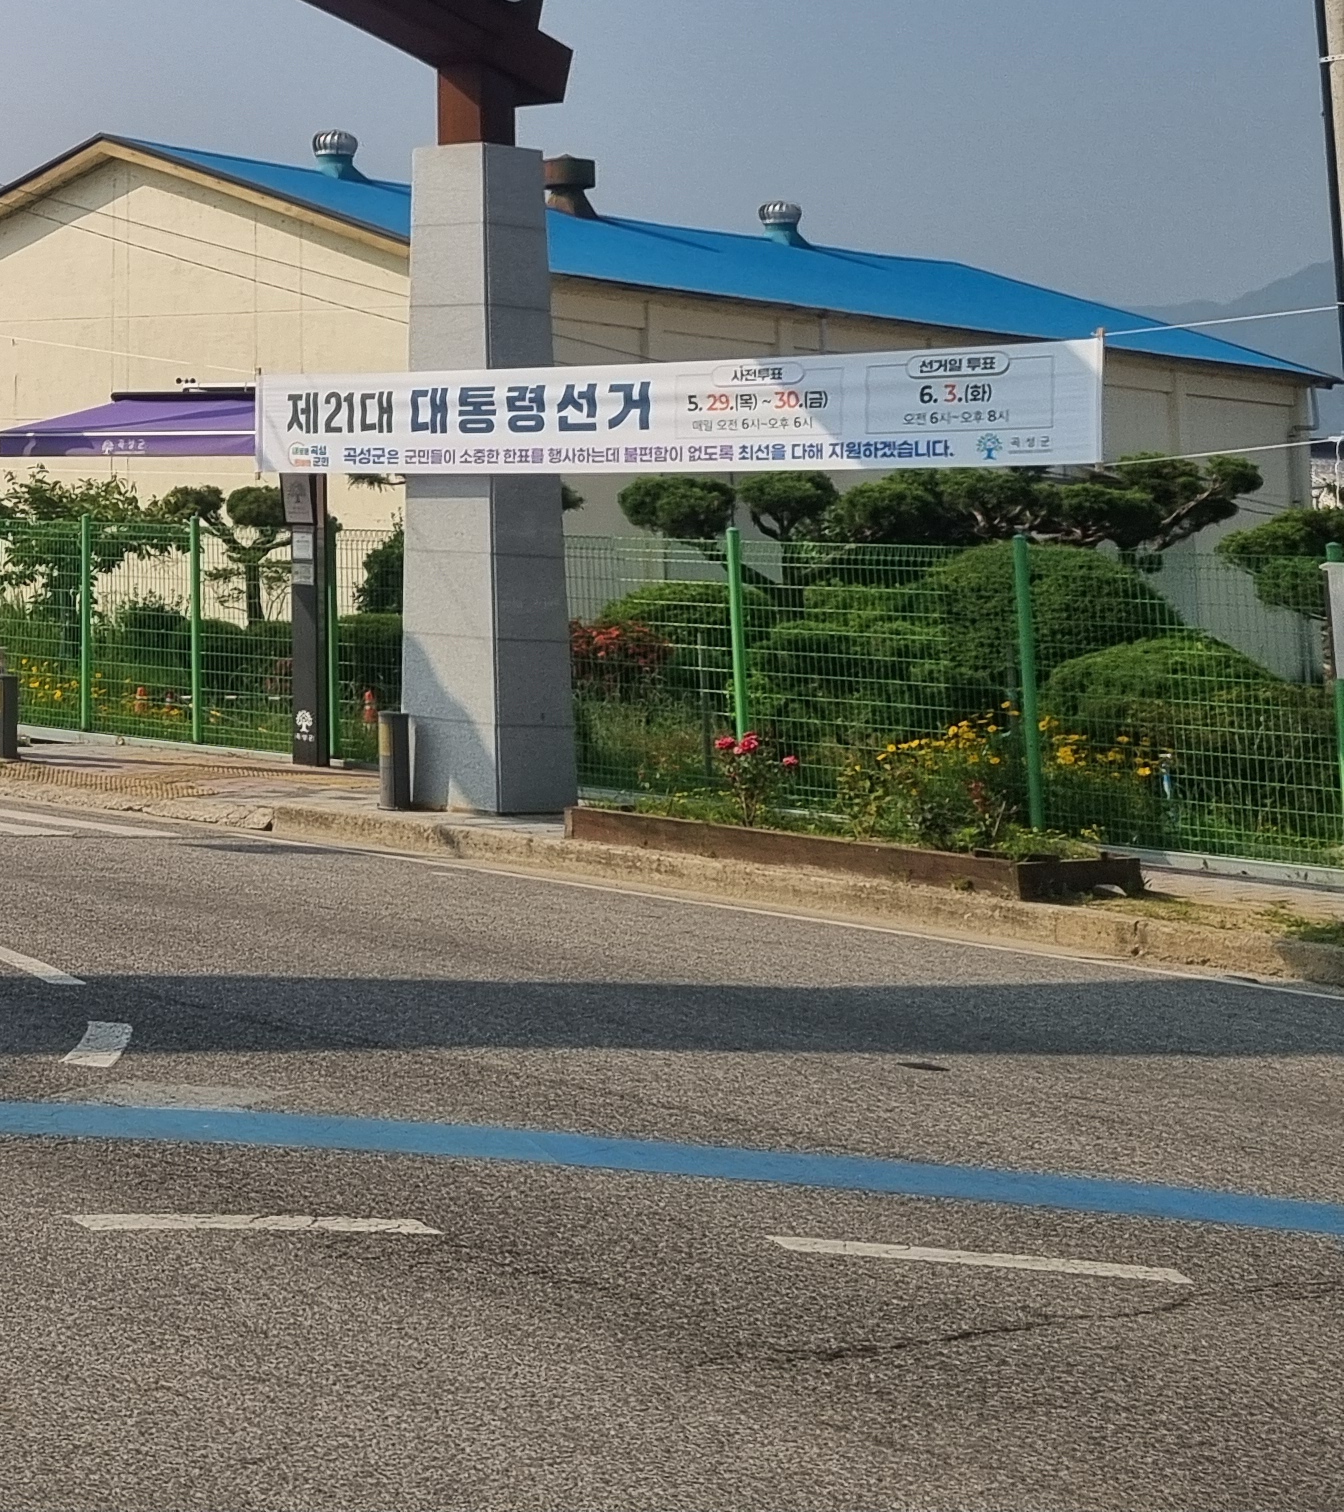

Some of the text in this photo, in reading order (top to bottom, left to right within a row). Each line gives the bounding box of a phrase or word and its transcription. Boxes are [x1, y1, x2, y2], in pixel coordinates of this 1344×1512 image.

[731, 366, 783, 383] 사전투표
[919, 356, 996, 374] 선거일 투표
[286, 380, 652, 435] 제21대 대통령선거
[343, 438, 955, 465] 곡성군은 군민들이 소중한 한표를 행사하는데 불편함이 없도록 최선을 다해 지원하겠습니다.
